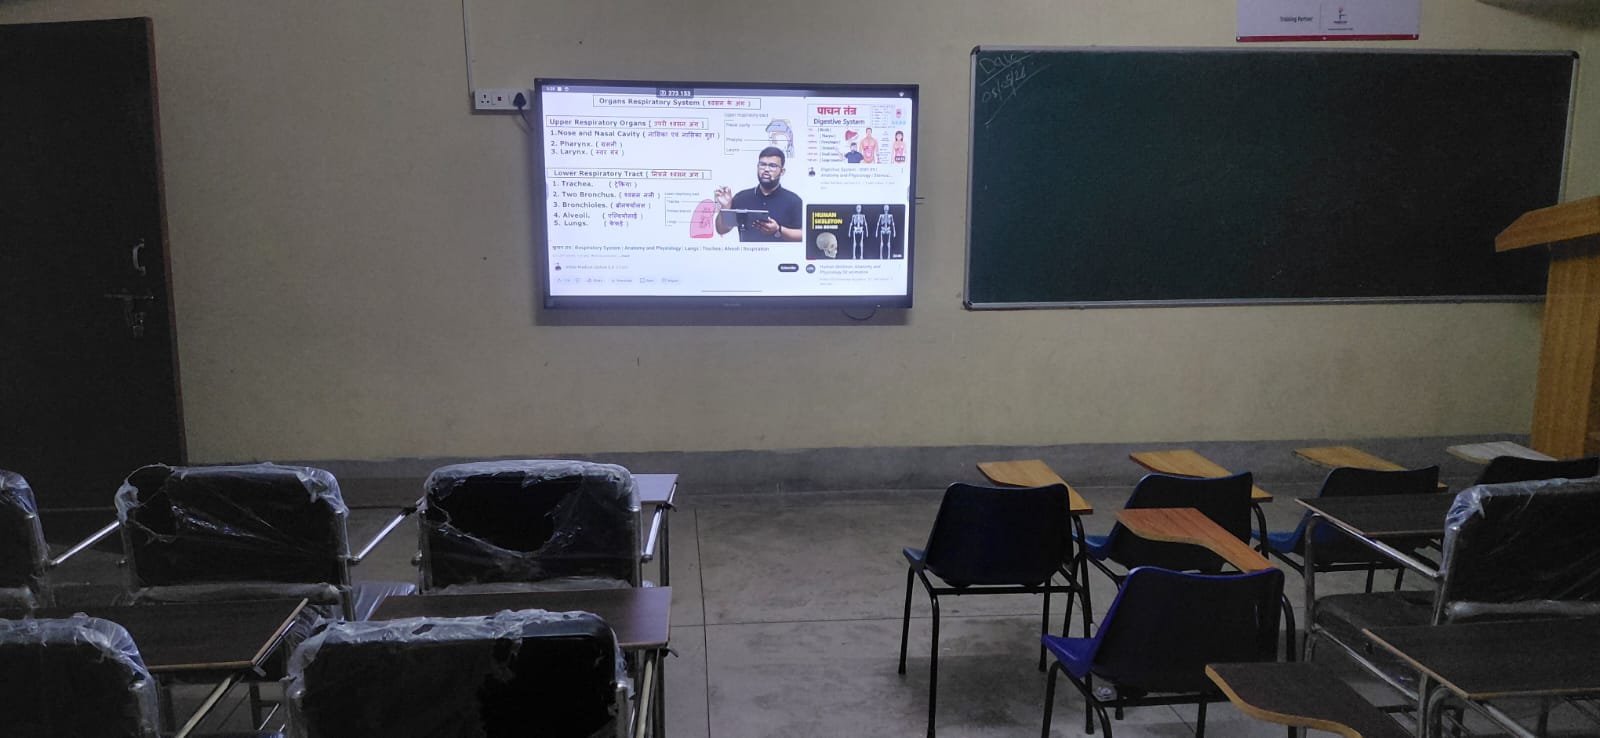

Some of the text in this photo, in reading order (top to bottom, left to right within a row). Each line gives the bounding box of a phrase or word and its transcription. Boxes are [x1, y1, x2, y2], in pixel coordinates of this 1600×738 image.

[599, 97, 626, 105] Organs
[628, 98, 671, 107] Respiratory
[673, 98, 700, 107] System
[817, 105, 857, 115] पाचन तंत्र
[549, 118, 572, 127] Upper
[574, 119, 617, 128] Respiratory
[619, 120, 646, 128] Organs
[813, 118, 865, 126] Digestive System
[560, 141, 593, 149] Pharynx.
[579, 170, 621, 179] Respiratory
